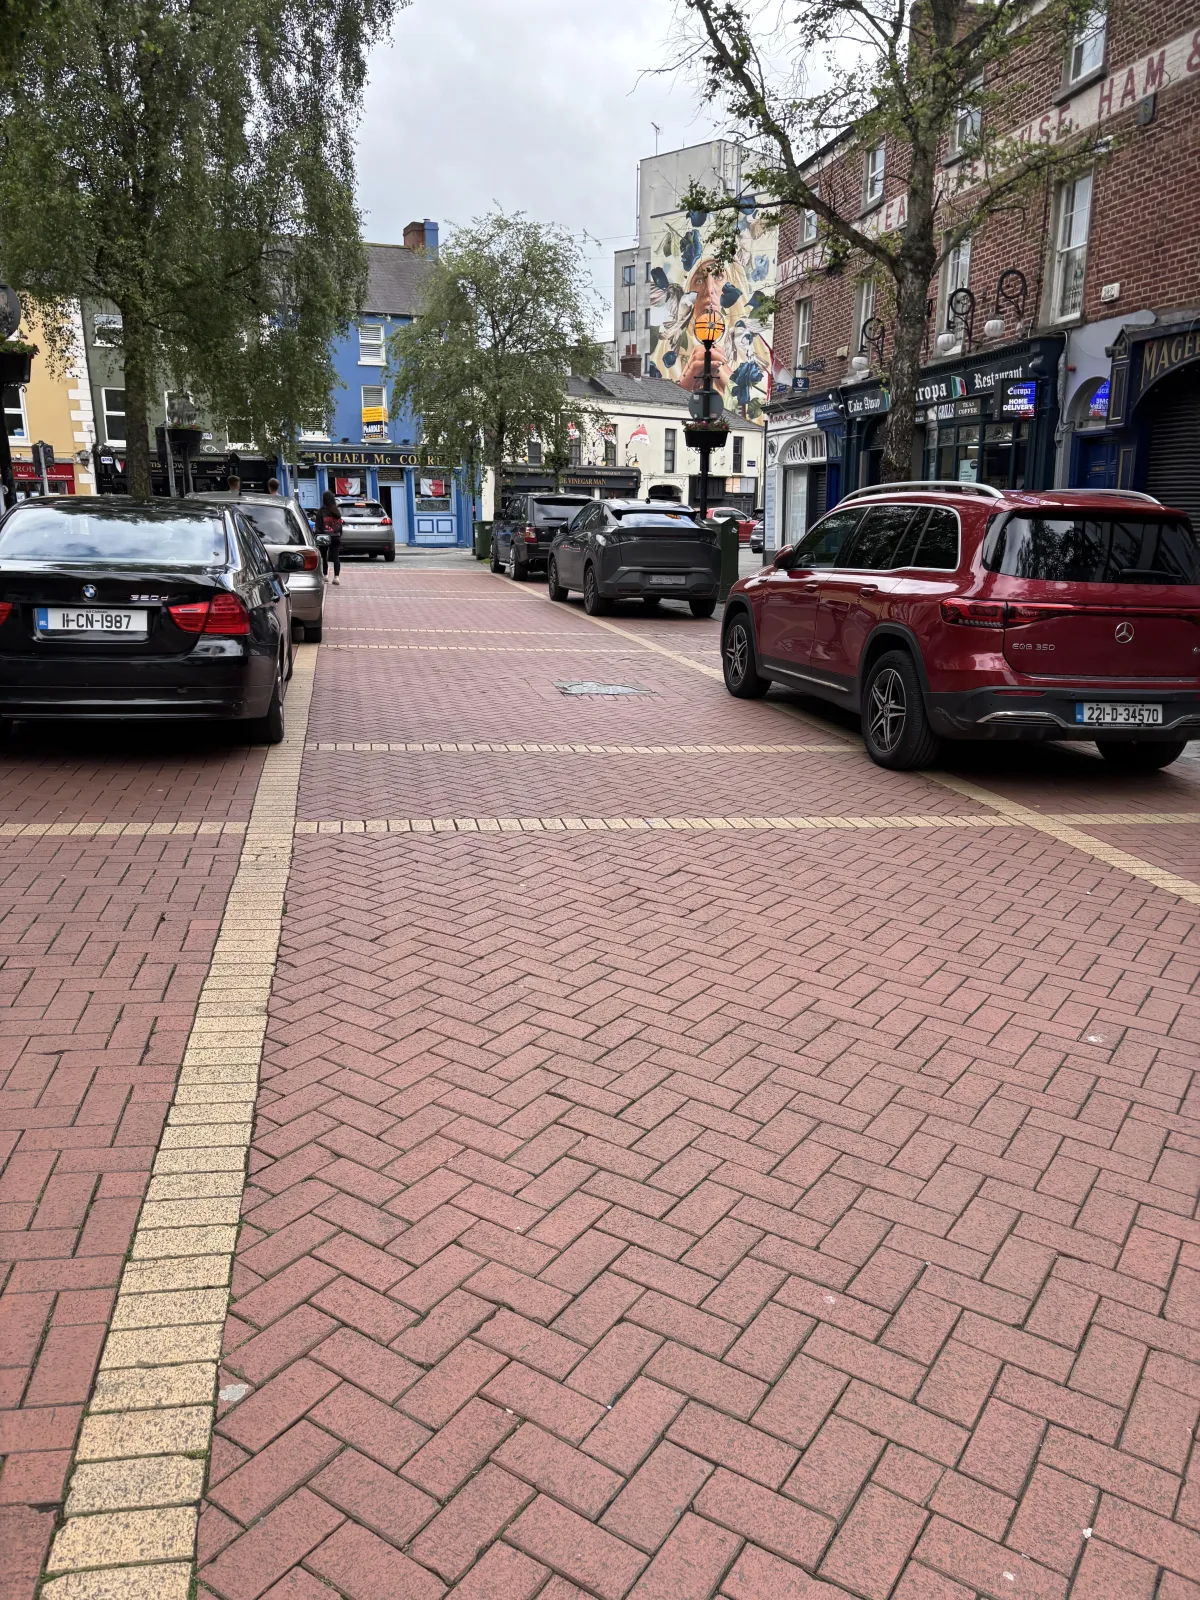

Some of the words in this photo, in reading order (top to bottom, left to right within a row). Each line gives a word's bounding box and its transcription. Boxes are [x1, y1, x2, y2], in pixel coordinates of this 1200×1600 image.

[1097, 50, 1166, 120] HAM
[915, 383, 948, 402] ropa
[974, 366, 1023, 389] Restaurant
[815, 402, 837, 413] MULHOLLAN
[848, 400, 863, 413] Take
[863, 396, 881, 410] Away
[958, 407, 978, 415] COFFEE
[937, 403, 955, 420] GRILLS
[315, 452, 369, 465] ICHAEL
[374, 453, 391, 465] Mc
[12, 465, 57, 474] PROPTY
[567, 478, 593, 486] VINEGAR
[593, 478, 607, 486] MAN
[1012, 643, 1033, 651] EQB
[1035, 643, 1056, 651] 350
[1087, 706, 1159, 723] 221-D-34570
